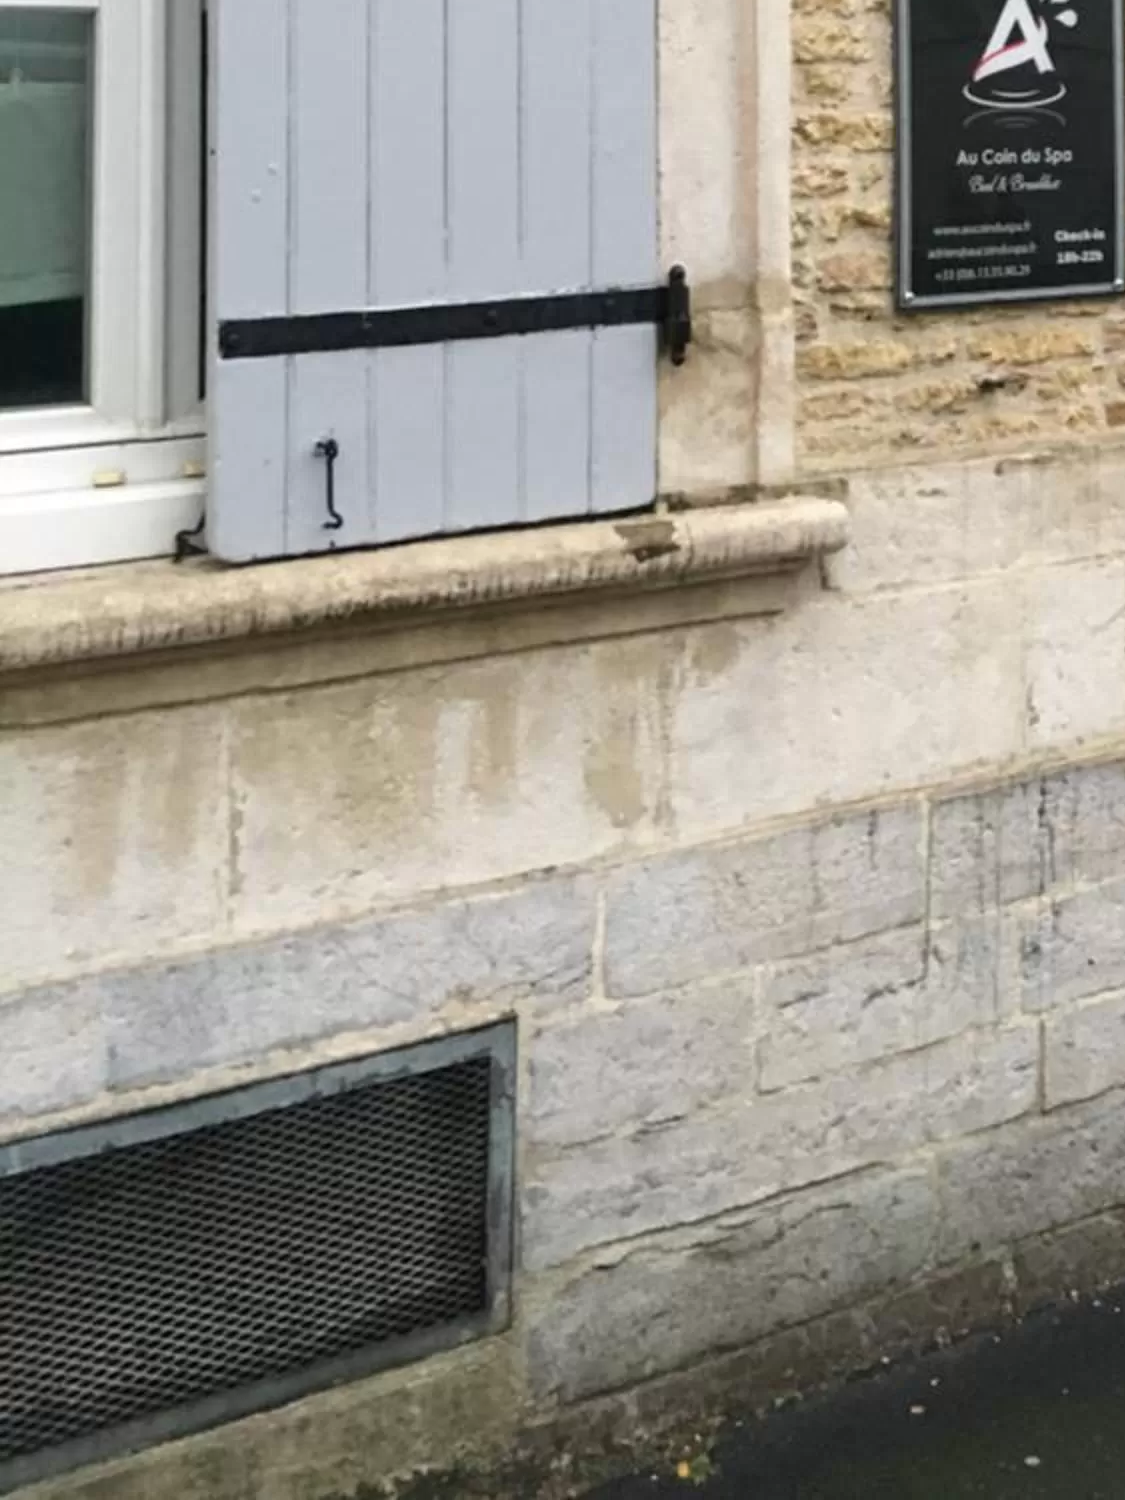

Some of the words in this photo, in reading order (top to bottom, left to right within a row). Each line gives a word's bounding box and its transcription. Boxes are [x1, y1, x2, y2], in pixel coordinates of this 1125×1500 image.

[956, 148, 979, 167] Au
[981, 147, 1018, 165] Coin
[1021, 148, 1041, 164] du
[1043, 146, 1073, 166] Spa
